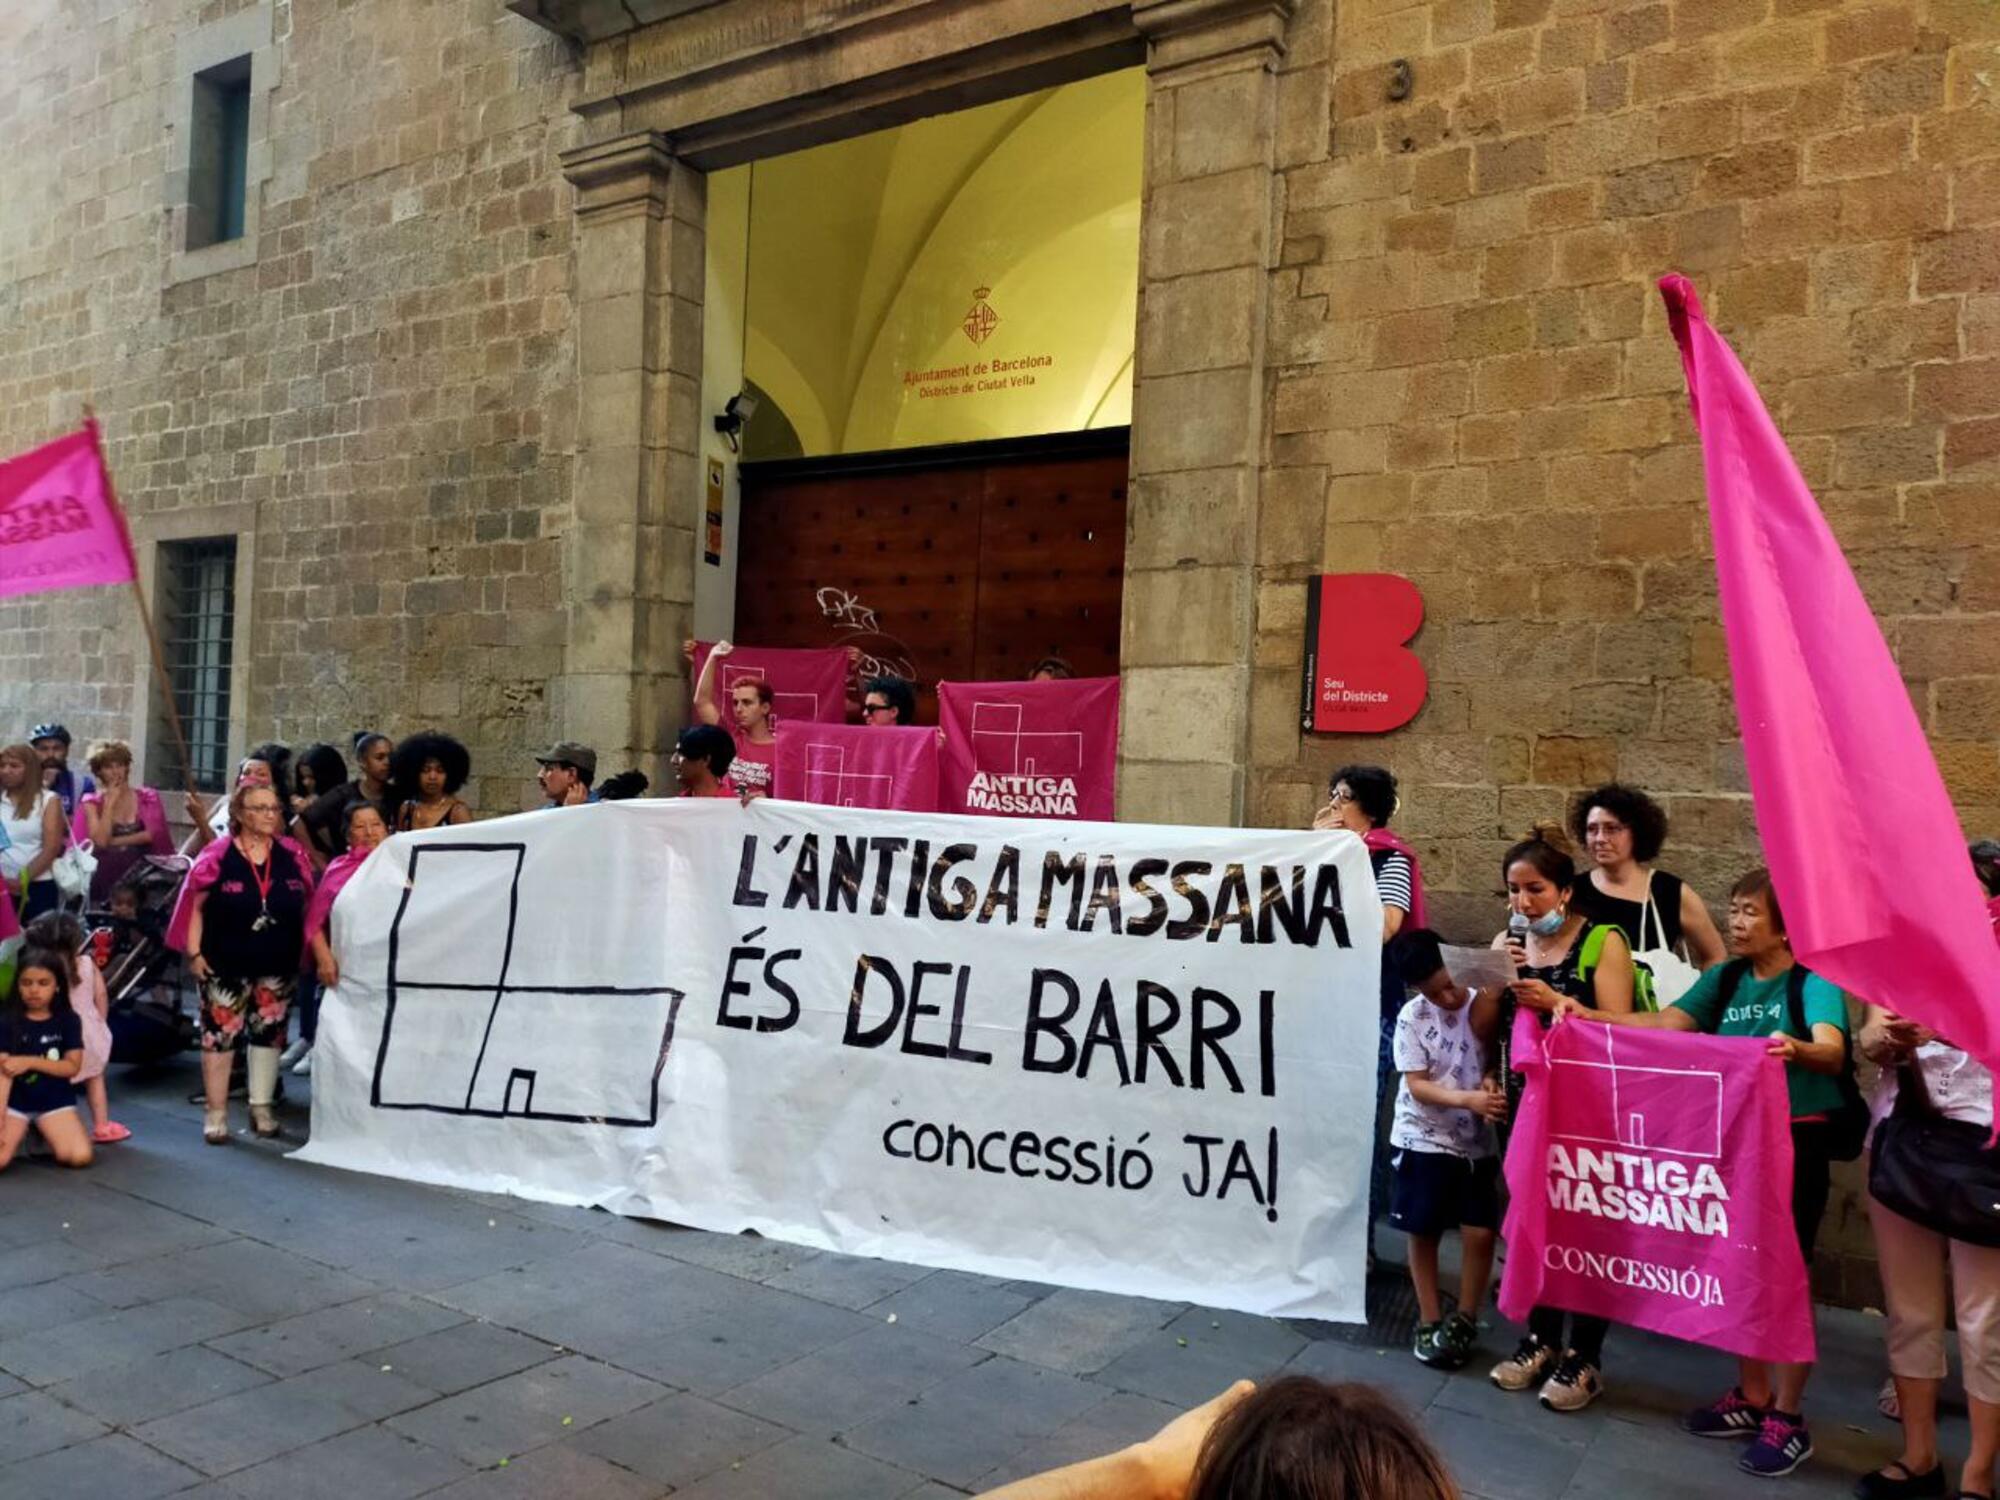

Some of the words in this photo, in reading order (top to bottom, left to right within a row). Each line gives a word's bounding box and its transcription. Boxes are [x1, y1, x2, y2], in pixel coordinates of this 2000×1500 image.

[903, 362, 970, 387] Ajuntament
[973, 362, 989, 376] de
[992, 354, 1053, 373] Barcelona
[919, 385, 960, 399] Districte
[962, 381, 975, 394] de
[977, 377, 1007, 392] Ciutat
[1010, 374, 1036, 388] Vella
[1323, 690, 1340, 701] del
[1343, 690, 1389, 703] Districte
[1324, 677, 1345, 689] Seu
[969, 772, 1078, 797] ANTIGA
[966, 788, 1078, 815] MASSANA
[732, 832, 1020, 925] L'ANTIGA
[1034, 850, 1353, 949] MASSANA
[716, 925, 802, 1033] ÉS
[842, 954, 993, 1062] DEL
[1023, 967, 1276, 1098] BARRI
[883, 1118, 1154, 1191] concessió
[1183, 1125, 1279, 1224] JA!
[1546, 1143, 1731, 1201] ANTIGA
[1546, 1176, 1729, 1239] MASSANA
